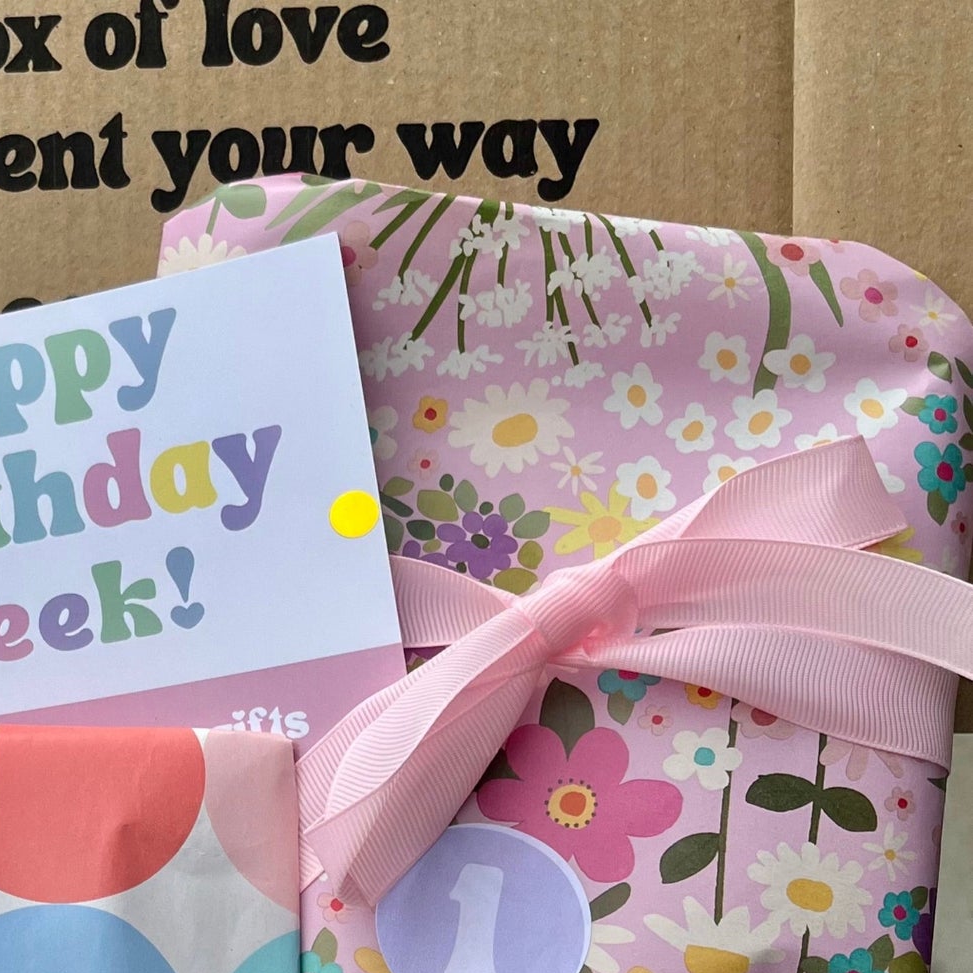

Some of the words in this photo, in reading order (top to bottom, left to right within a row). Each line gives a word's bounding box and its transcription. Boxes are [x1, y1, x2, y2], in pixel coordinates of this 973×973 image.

[84, 0, 180, 70] of
[202, 0, 390, 66] love
[151, 123, 375, 213] your
[396, 118, 600, 202] way
[214, 706, 310, 739] ifts
